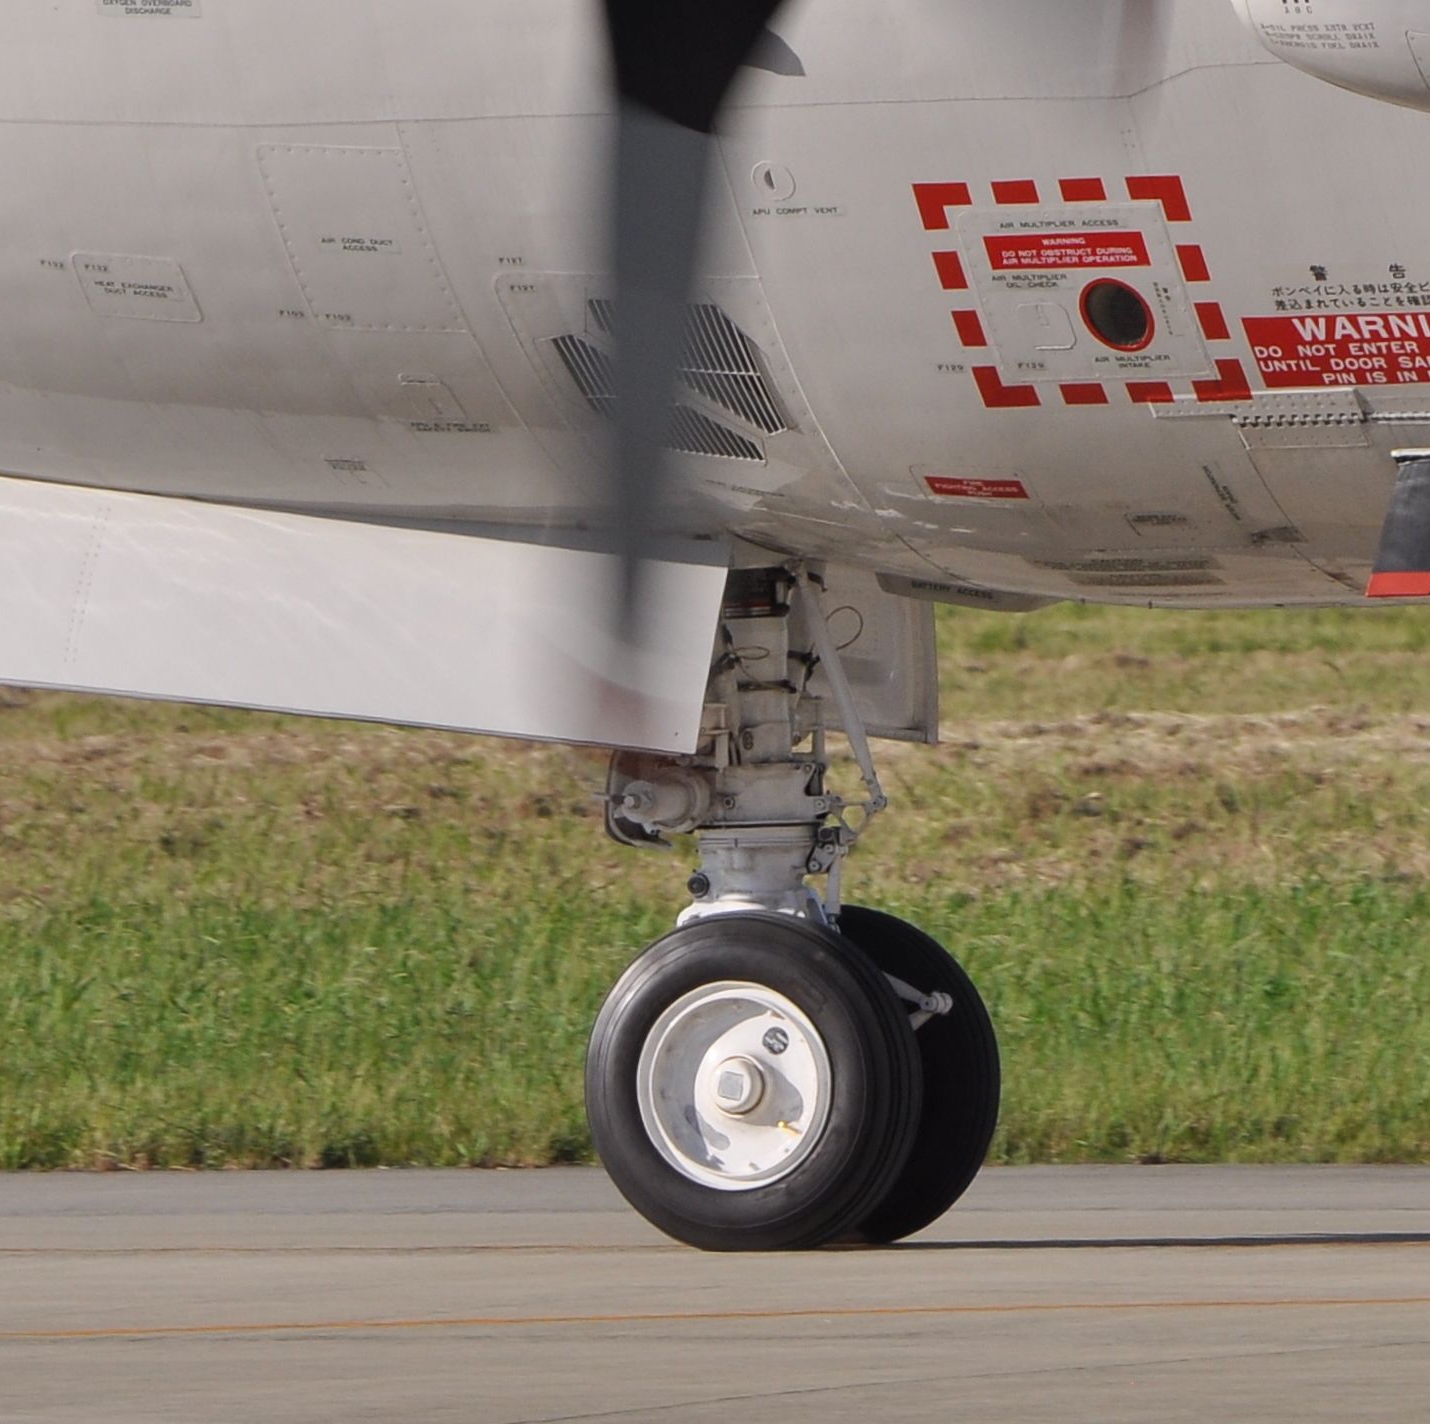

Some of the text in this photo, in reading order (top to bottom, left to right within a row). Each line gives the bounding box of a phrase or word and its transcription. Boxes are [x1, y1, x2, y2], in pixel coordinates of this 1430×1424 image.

[141, 0, 193, 7] OVERBOARD
[125, 7, 172, 15] DISCHARGE
[1081, 219, 1119, 227] ACCESS
[1042, 237, 1086, 245] WARNING
[1002, 250, 1015, 258] DO
[1041, 248, 1091, 257] OBSTRUCT
[1096, 247, 1133, 255] DURING
[1021, 256, 1079, 265] MULTIPLIER
[1082, 255, 1137, 263] OPERATION
[1011, 273, 1067, 281] MULTIPLIER
[1253, 346, 1283, 359] DO
[1298, 343, 1337, 358] NOT
[1349, 341, 1421, 356] ENTER
[1114, 354, 1171, 362] MULTIPLIER
[1259, 359, 1321, 373] UNTIL
[1330, 356, 1387, 371] DOOR
[1322, 371, 1357, 385] PIN
[1366, 370, 1387, 383] IS
[1397, 369, 1419, 382] IN
